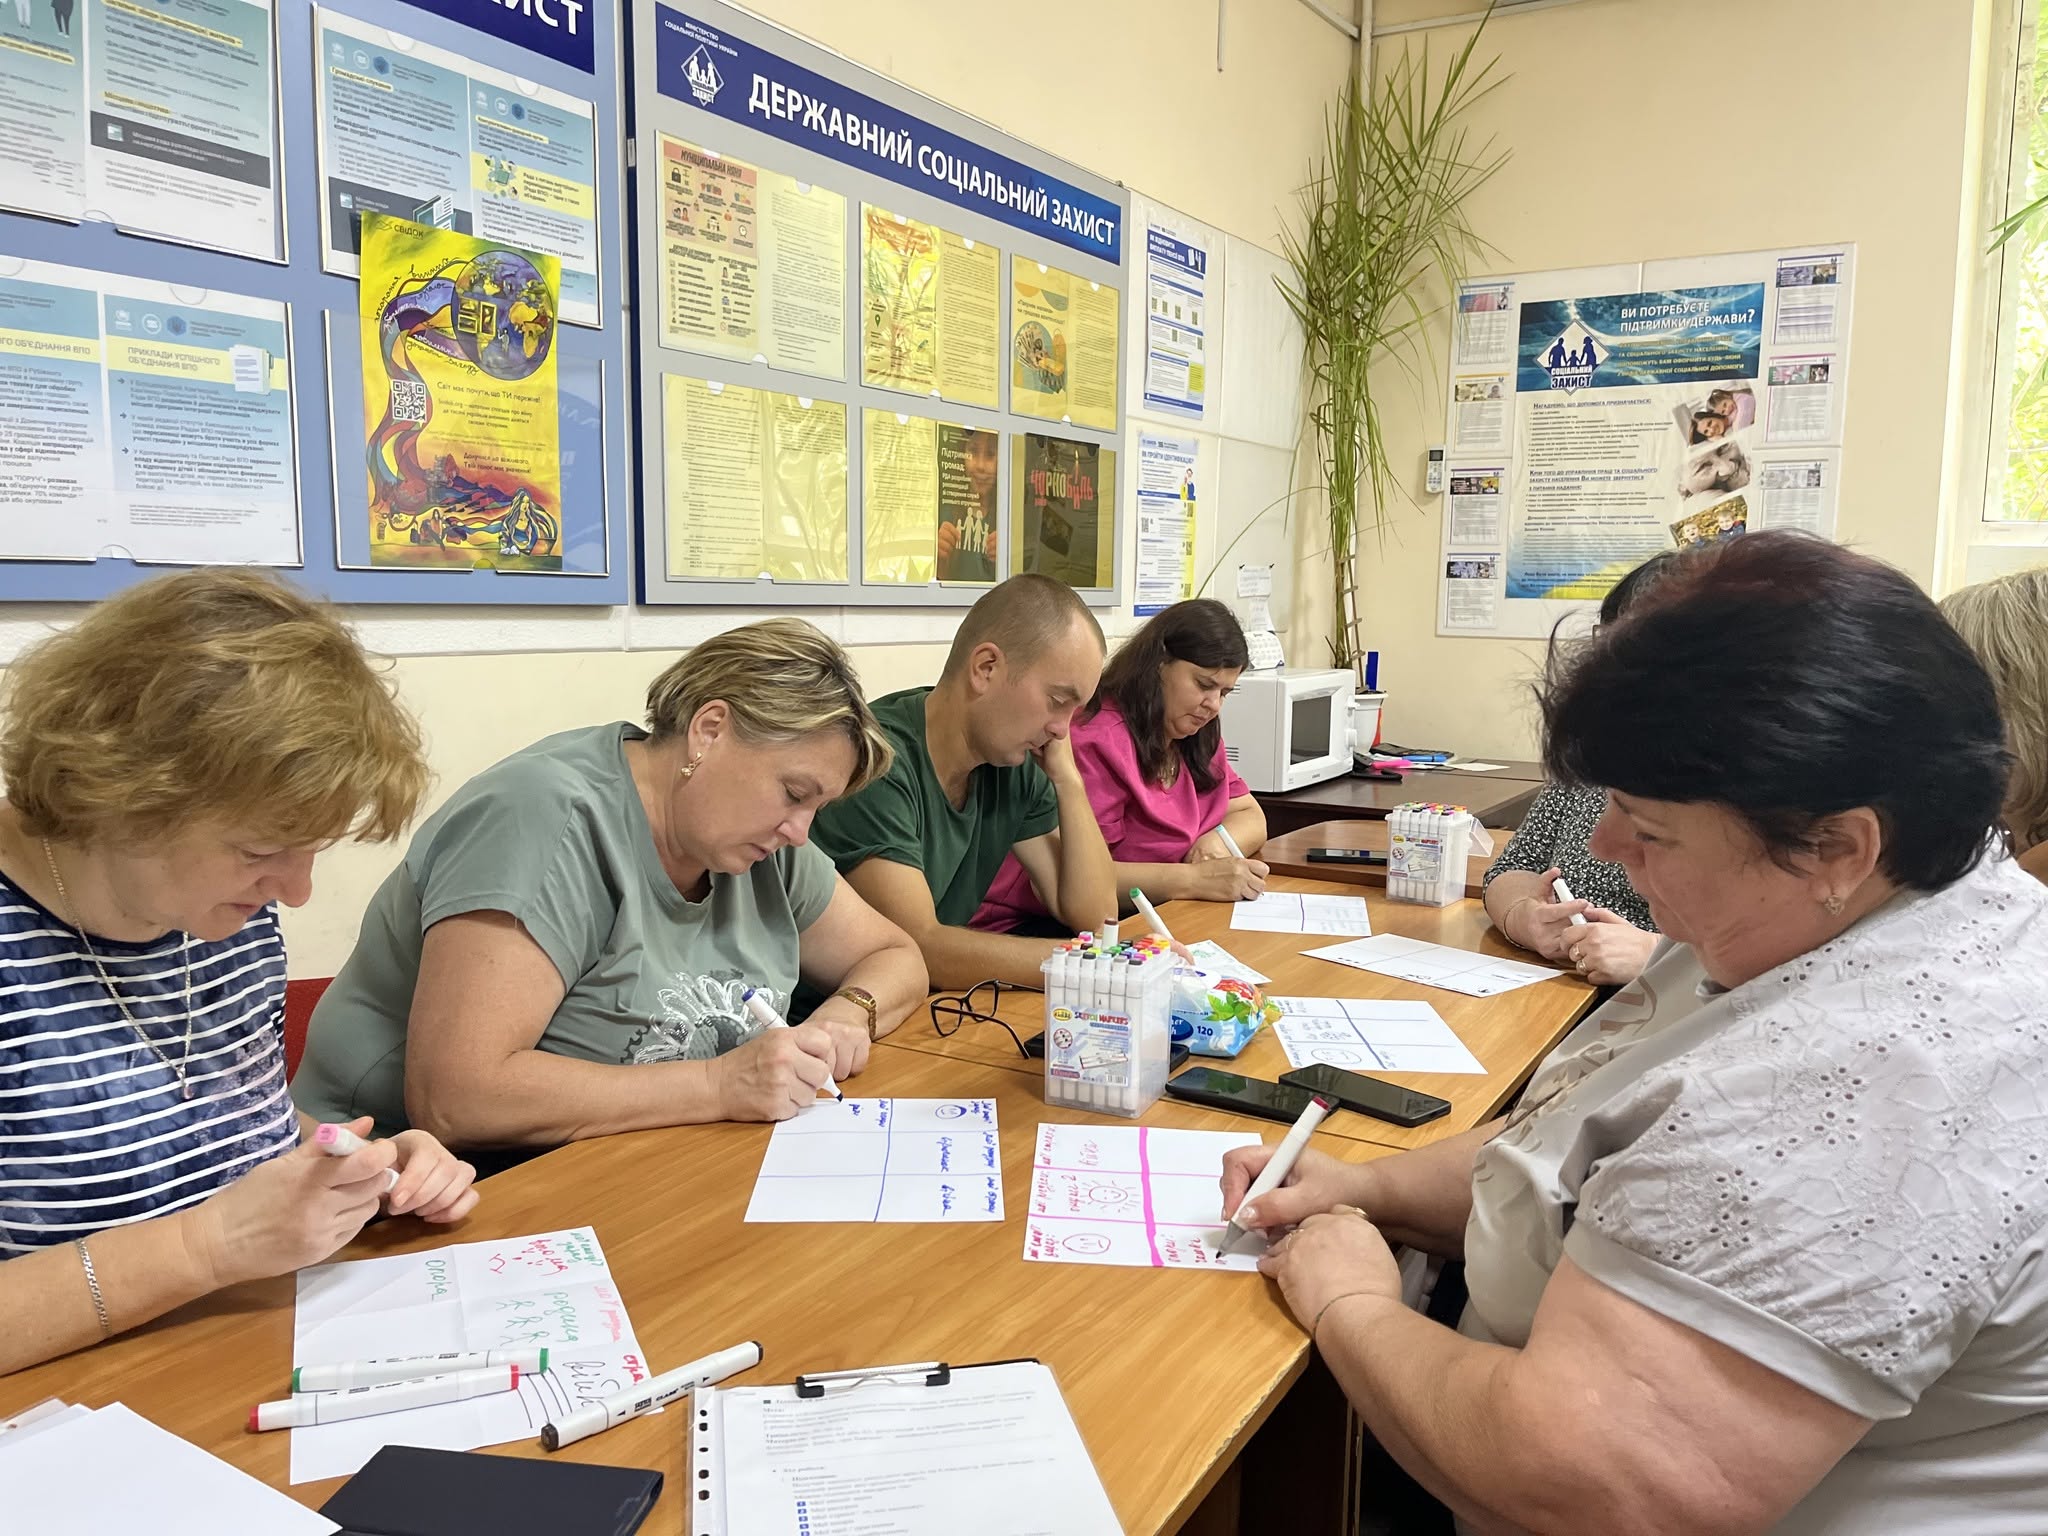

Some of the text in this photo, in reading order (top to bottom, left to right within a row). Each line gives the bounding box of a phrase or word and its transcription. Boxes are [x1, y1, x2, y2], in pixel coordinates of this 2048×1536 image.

[718, 43, 738, 57] УКРАЇНИ
[748, 73, 1116, 246] ДЕРЖАВНИЙ СОЦІАЛЬНИЙ ЗАХИСТ
[1620, 301, 1711, 319] ВИ ПОТРЕБУЄТЕ
[1620, 308, 1756, 334] ПІДТРИМКИ ДЕРЖАВИ?
[72, 345, 91, 355] ВПО
[1551, 364, 1593, 377] СОЦІАЛЬНИЙ
[1552, 376, 1592, 389] ЗАХИСТ
[502, 391, 512, 399] ТИ
[1197, 1025, 1213, 1036] 120
